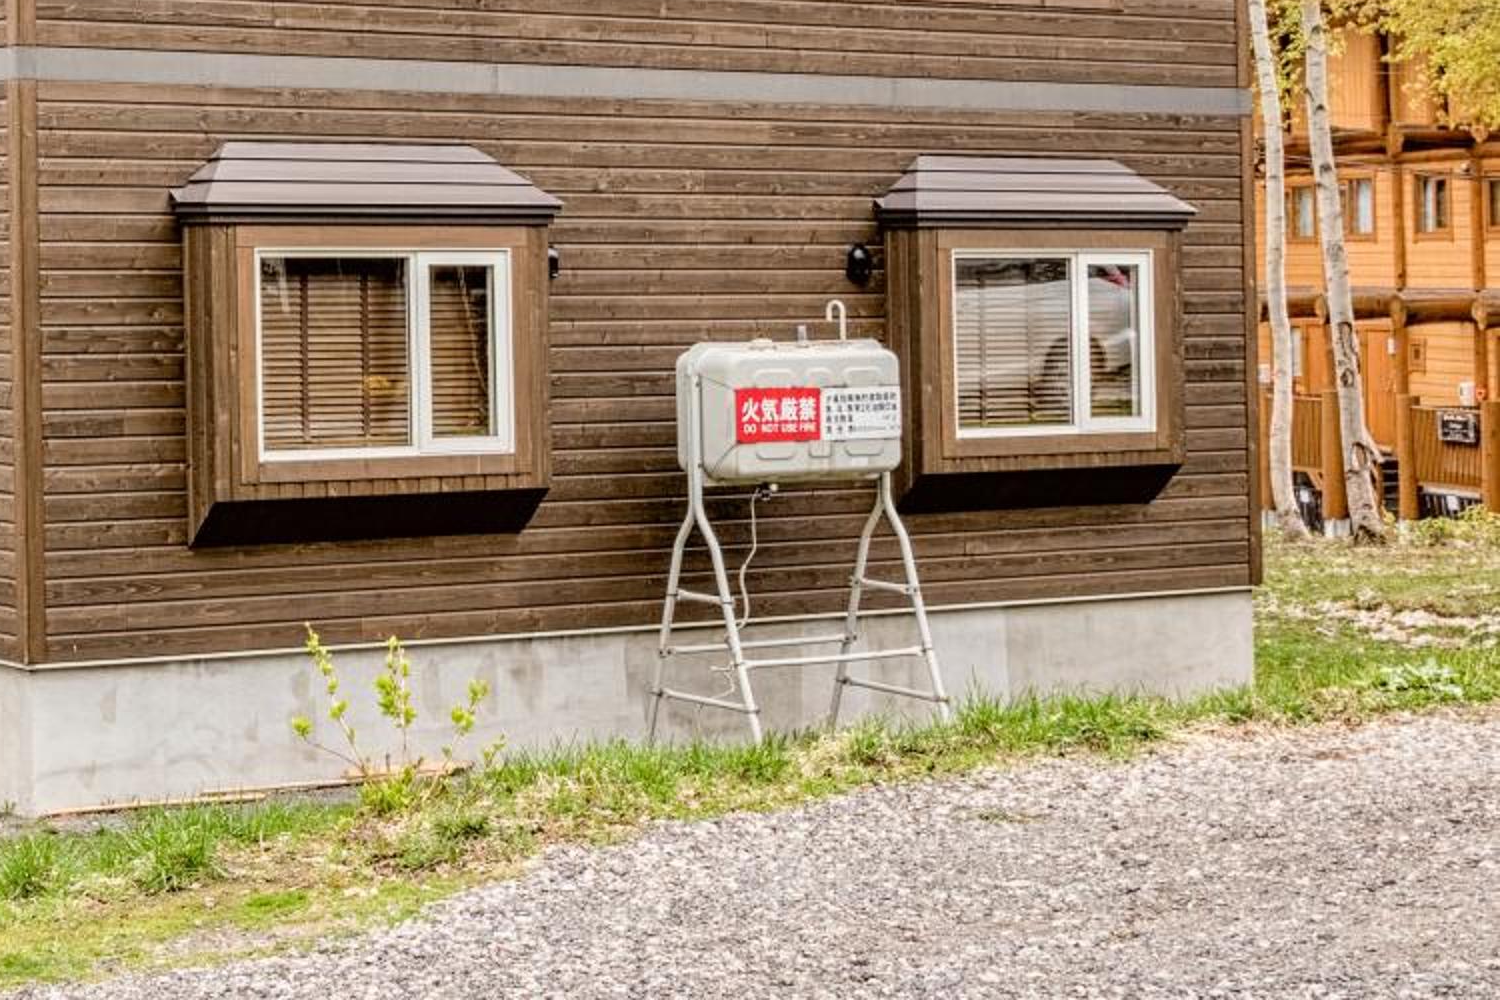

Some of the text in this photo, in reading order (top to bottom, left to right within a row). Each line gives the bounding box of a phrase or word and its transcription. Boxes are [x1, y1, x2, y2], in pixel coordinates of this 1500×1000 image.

[742, 397, 816, 423] 火気厳禁
[743, 424, 757, 435] DO
[761, 423, 779, 433] NOT
